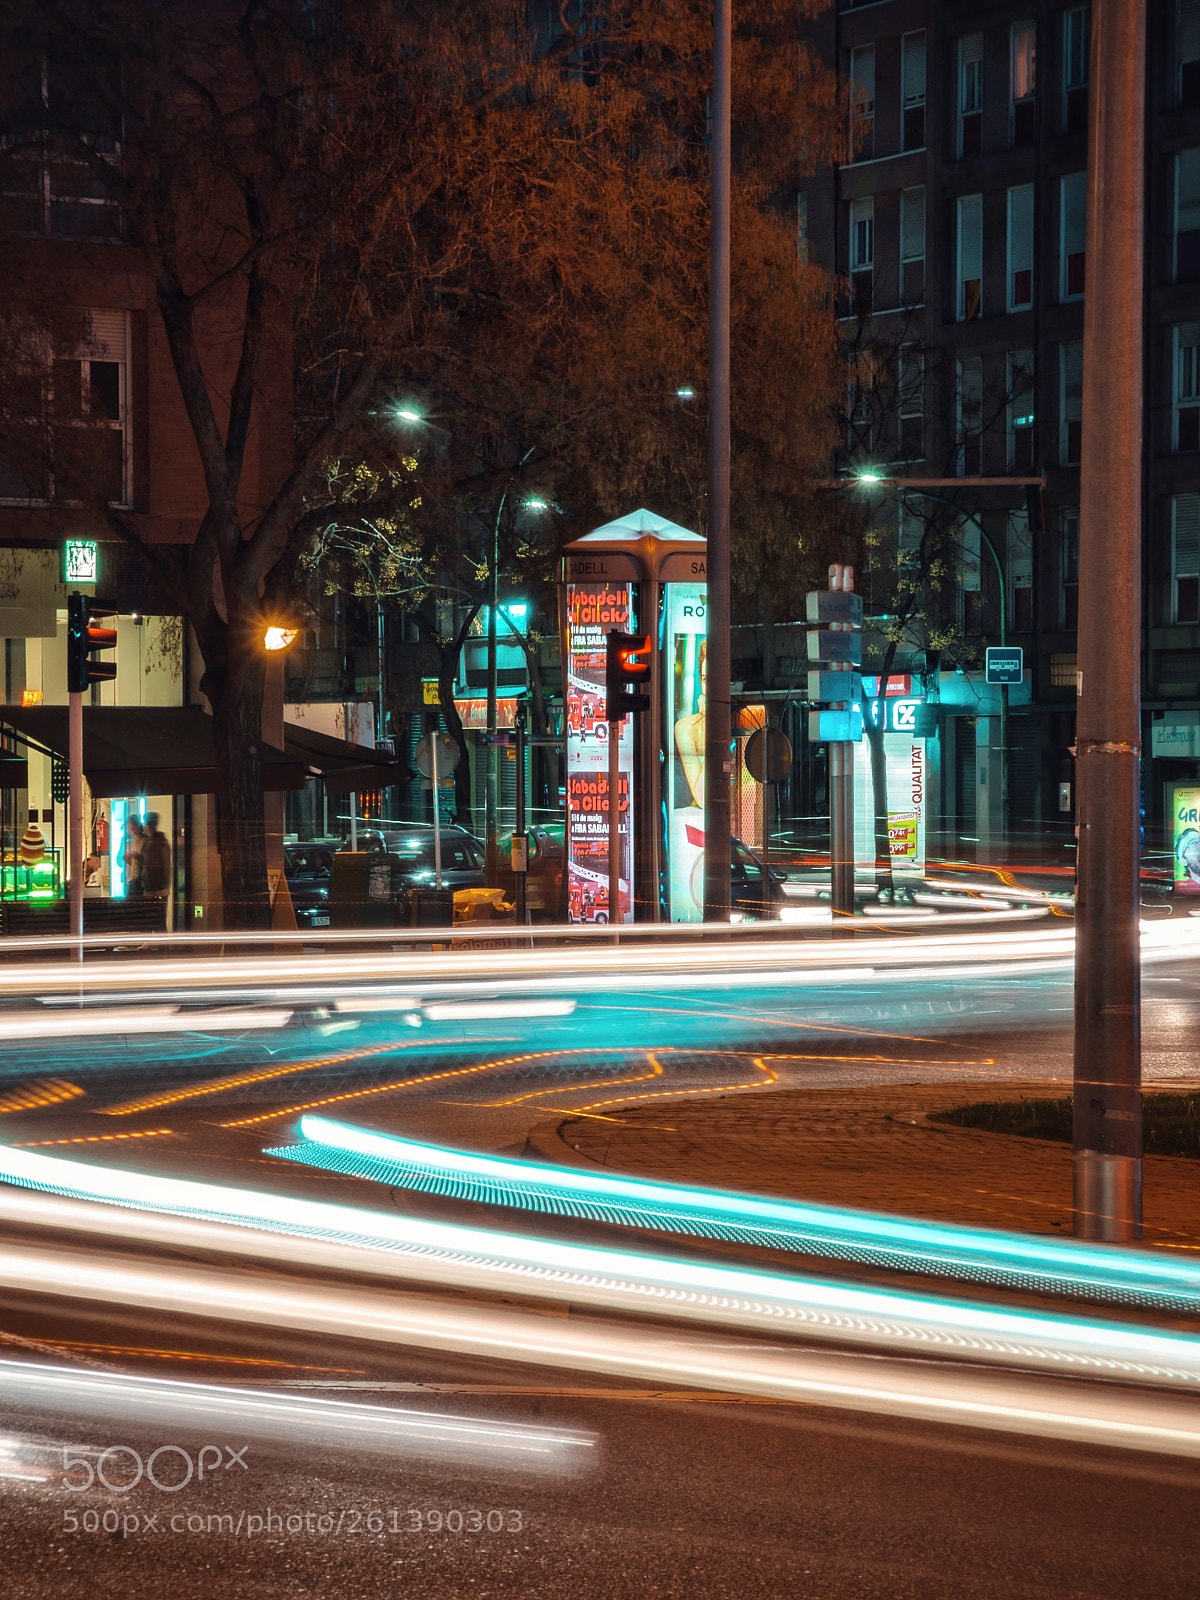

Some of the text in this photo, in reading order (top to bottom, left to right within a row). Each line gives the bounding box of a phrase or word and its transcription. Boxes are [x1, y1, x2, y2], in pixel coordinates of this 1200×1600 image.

[569, 562, 608, 574] ADELL
[581, 607, 628, 623] Clicks
[683, 605, 705, 617] RO
[587, 635, 607, 645] SABA
[911, 744, 922, 804] QUALITAT
[568, 779, 628, 794] Sabadll
[582, 796, 629, 811] Clics
[588, 823, 628, 833] SABALL
